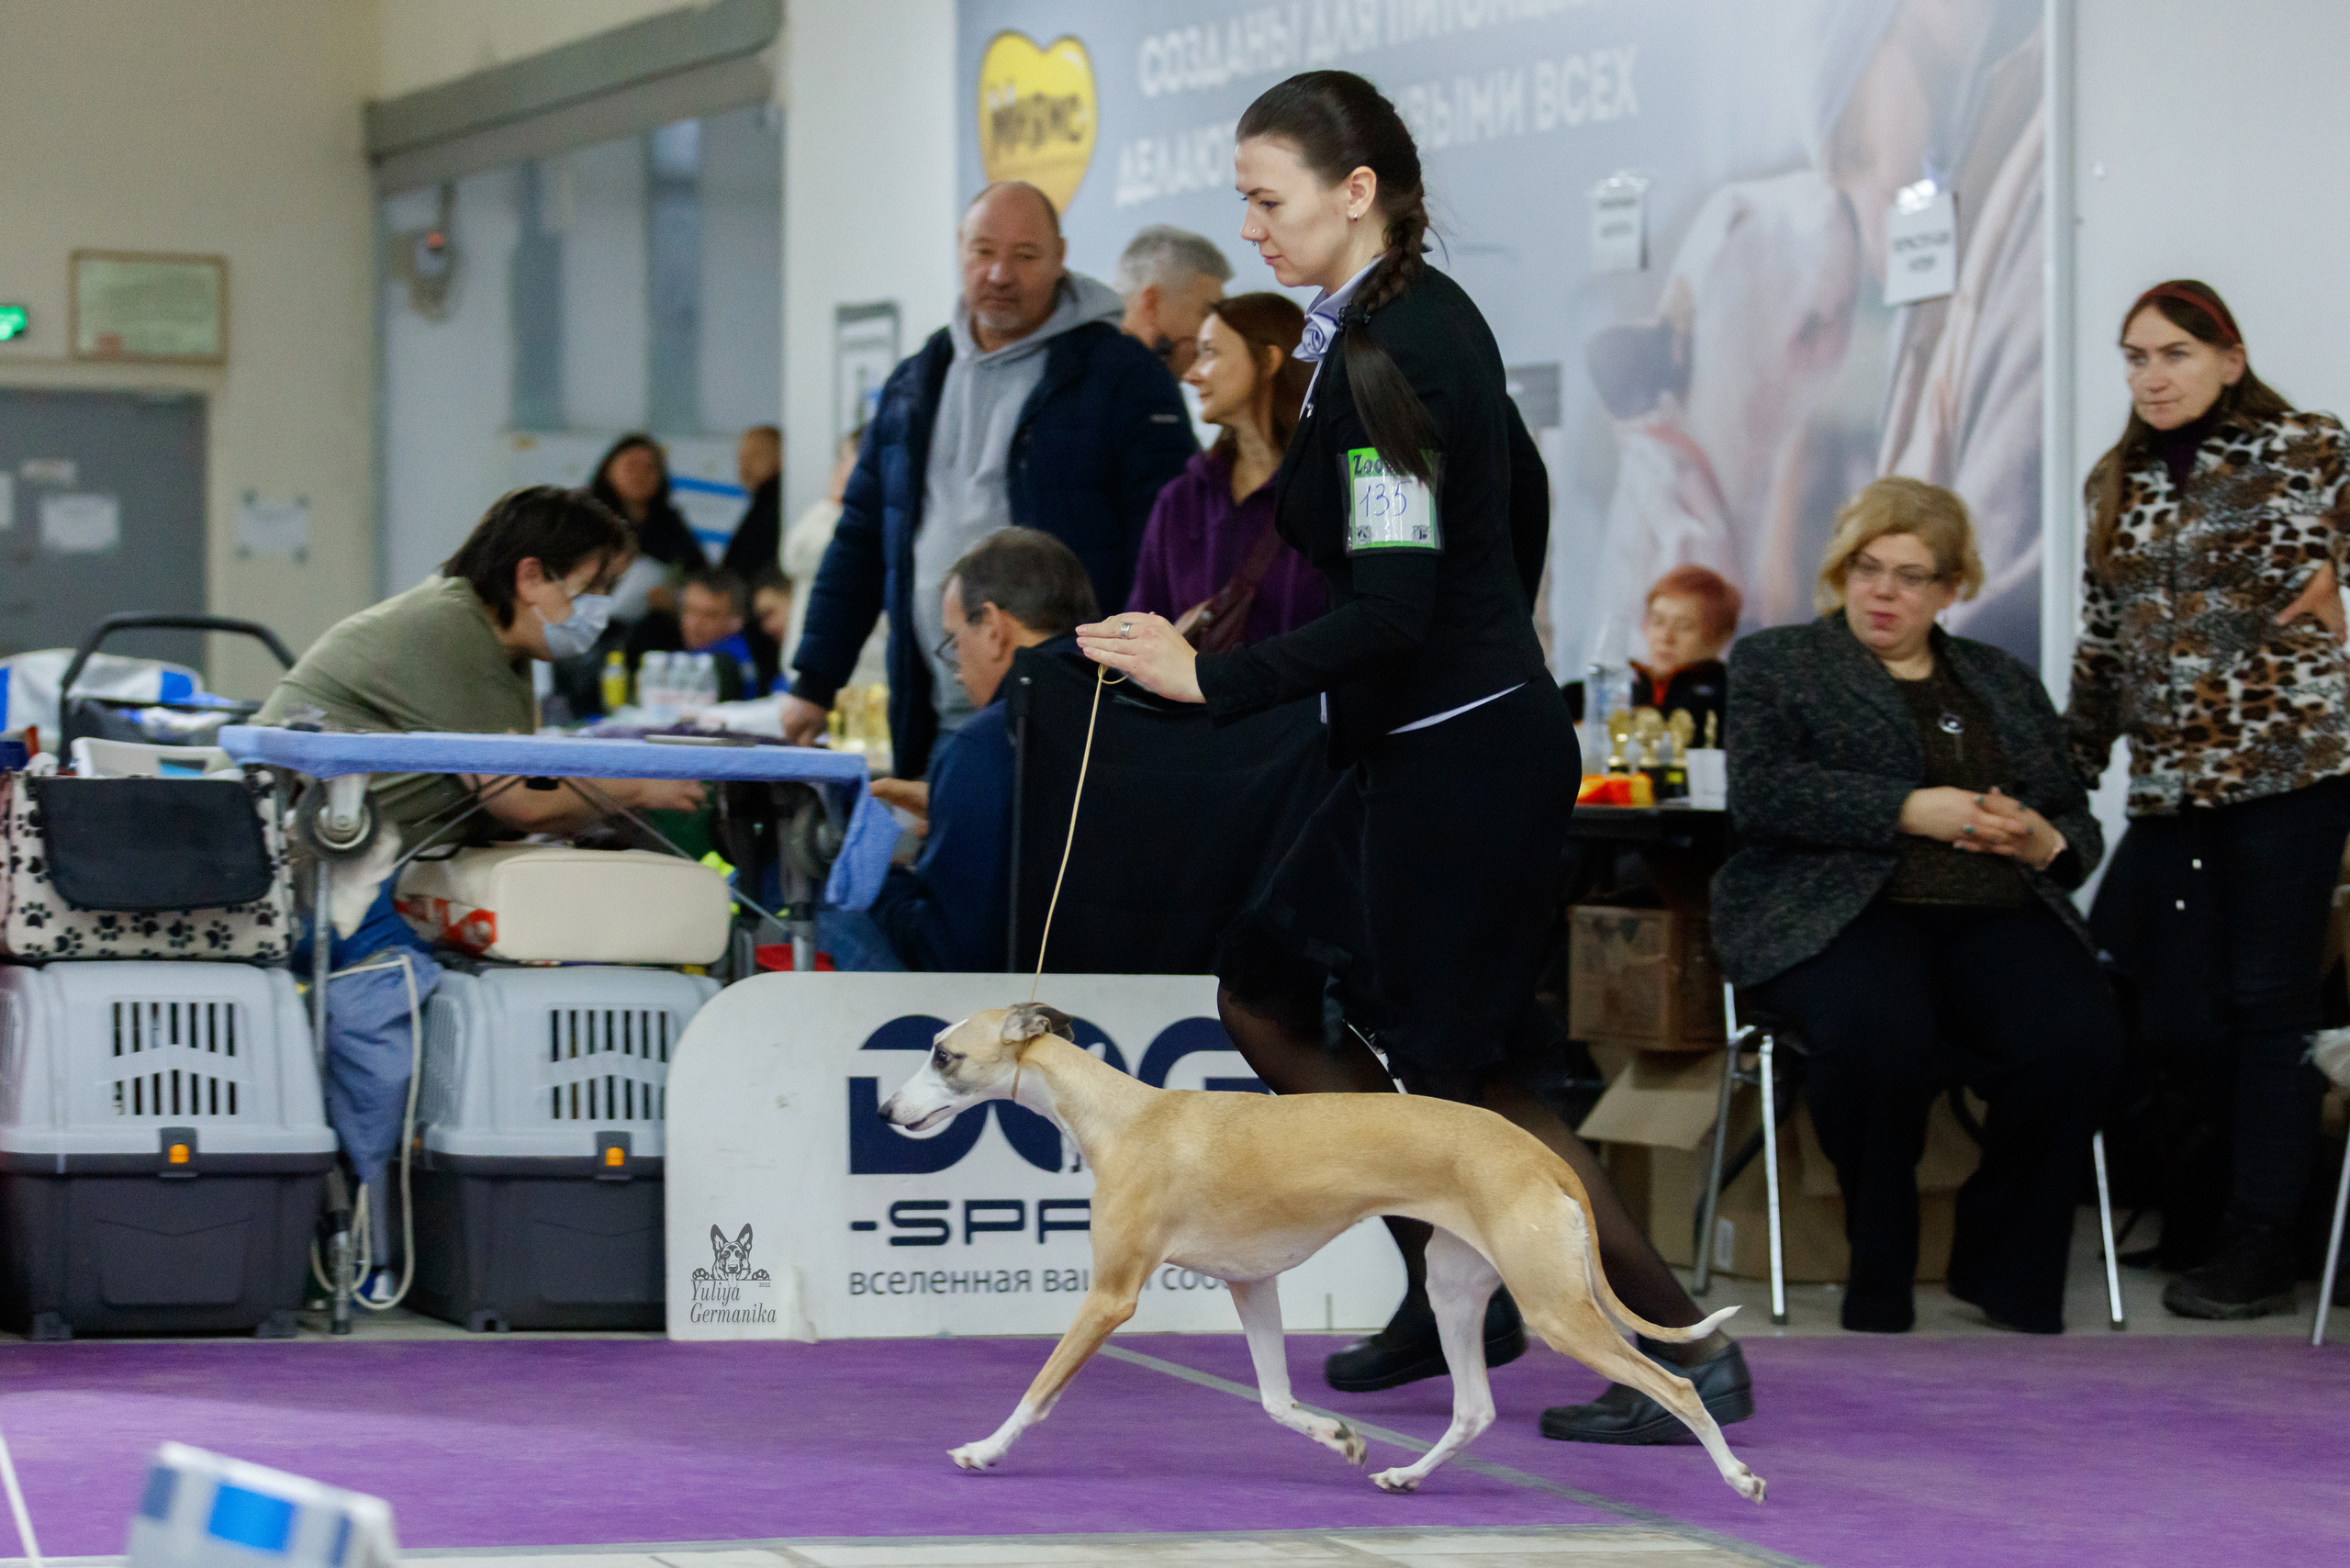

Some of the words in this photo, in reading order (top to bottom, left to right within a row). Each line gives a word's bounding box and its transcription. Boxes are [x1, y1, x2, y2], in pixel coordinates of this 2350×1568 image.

[1534, 43, 1639, 132] ВСЕХ
[1360, 479, 1413, 518] 135
[849, 1268, 1033, 1295] вселенная
